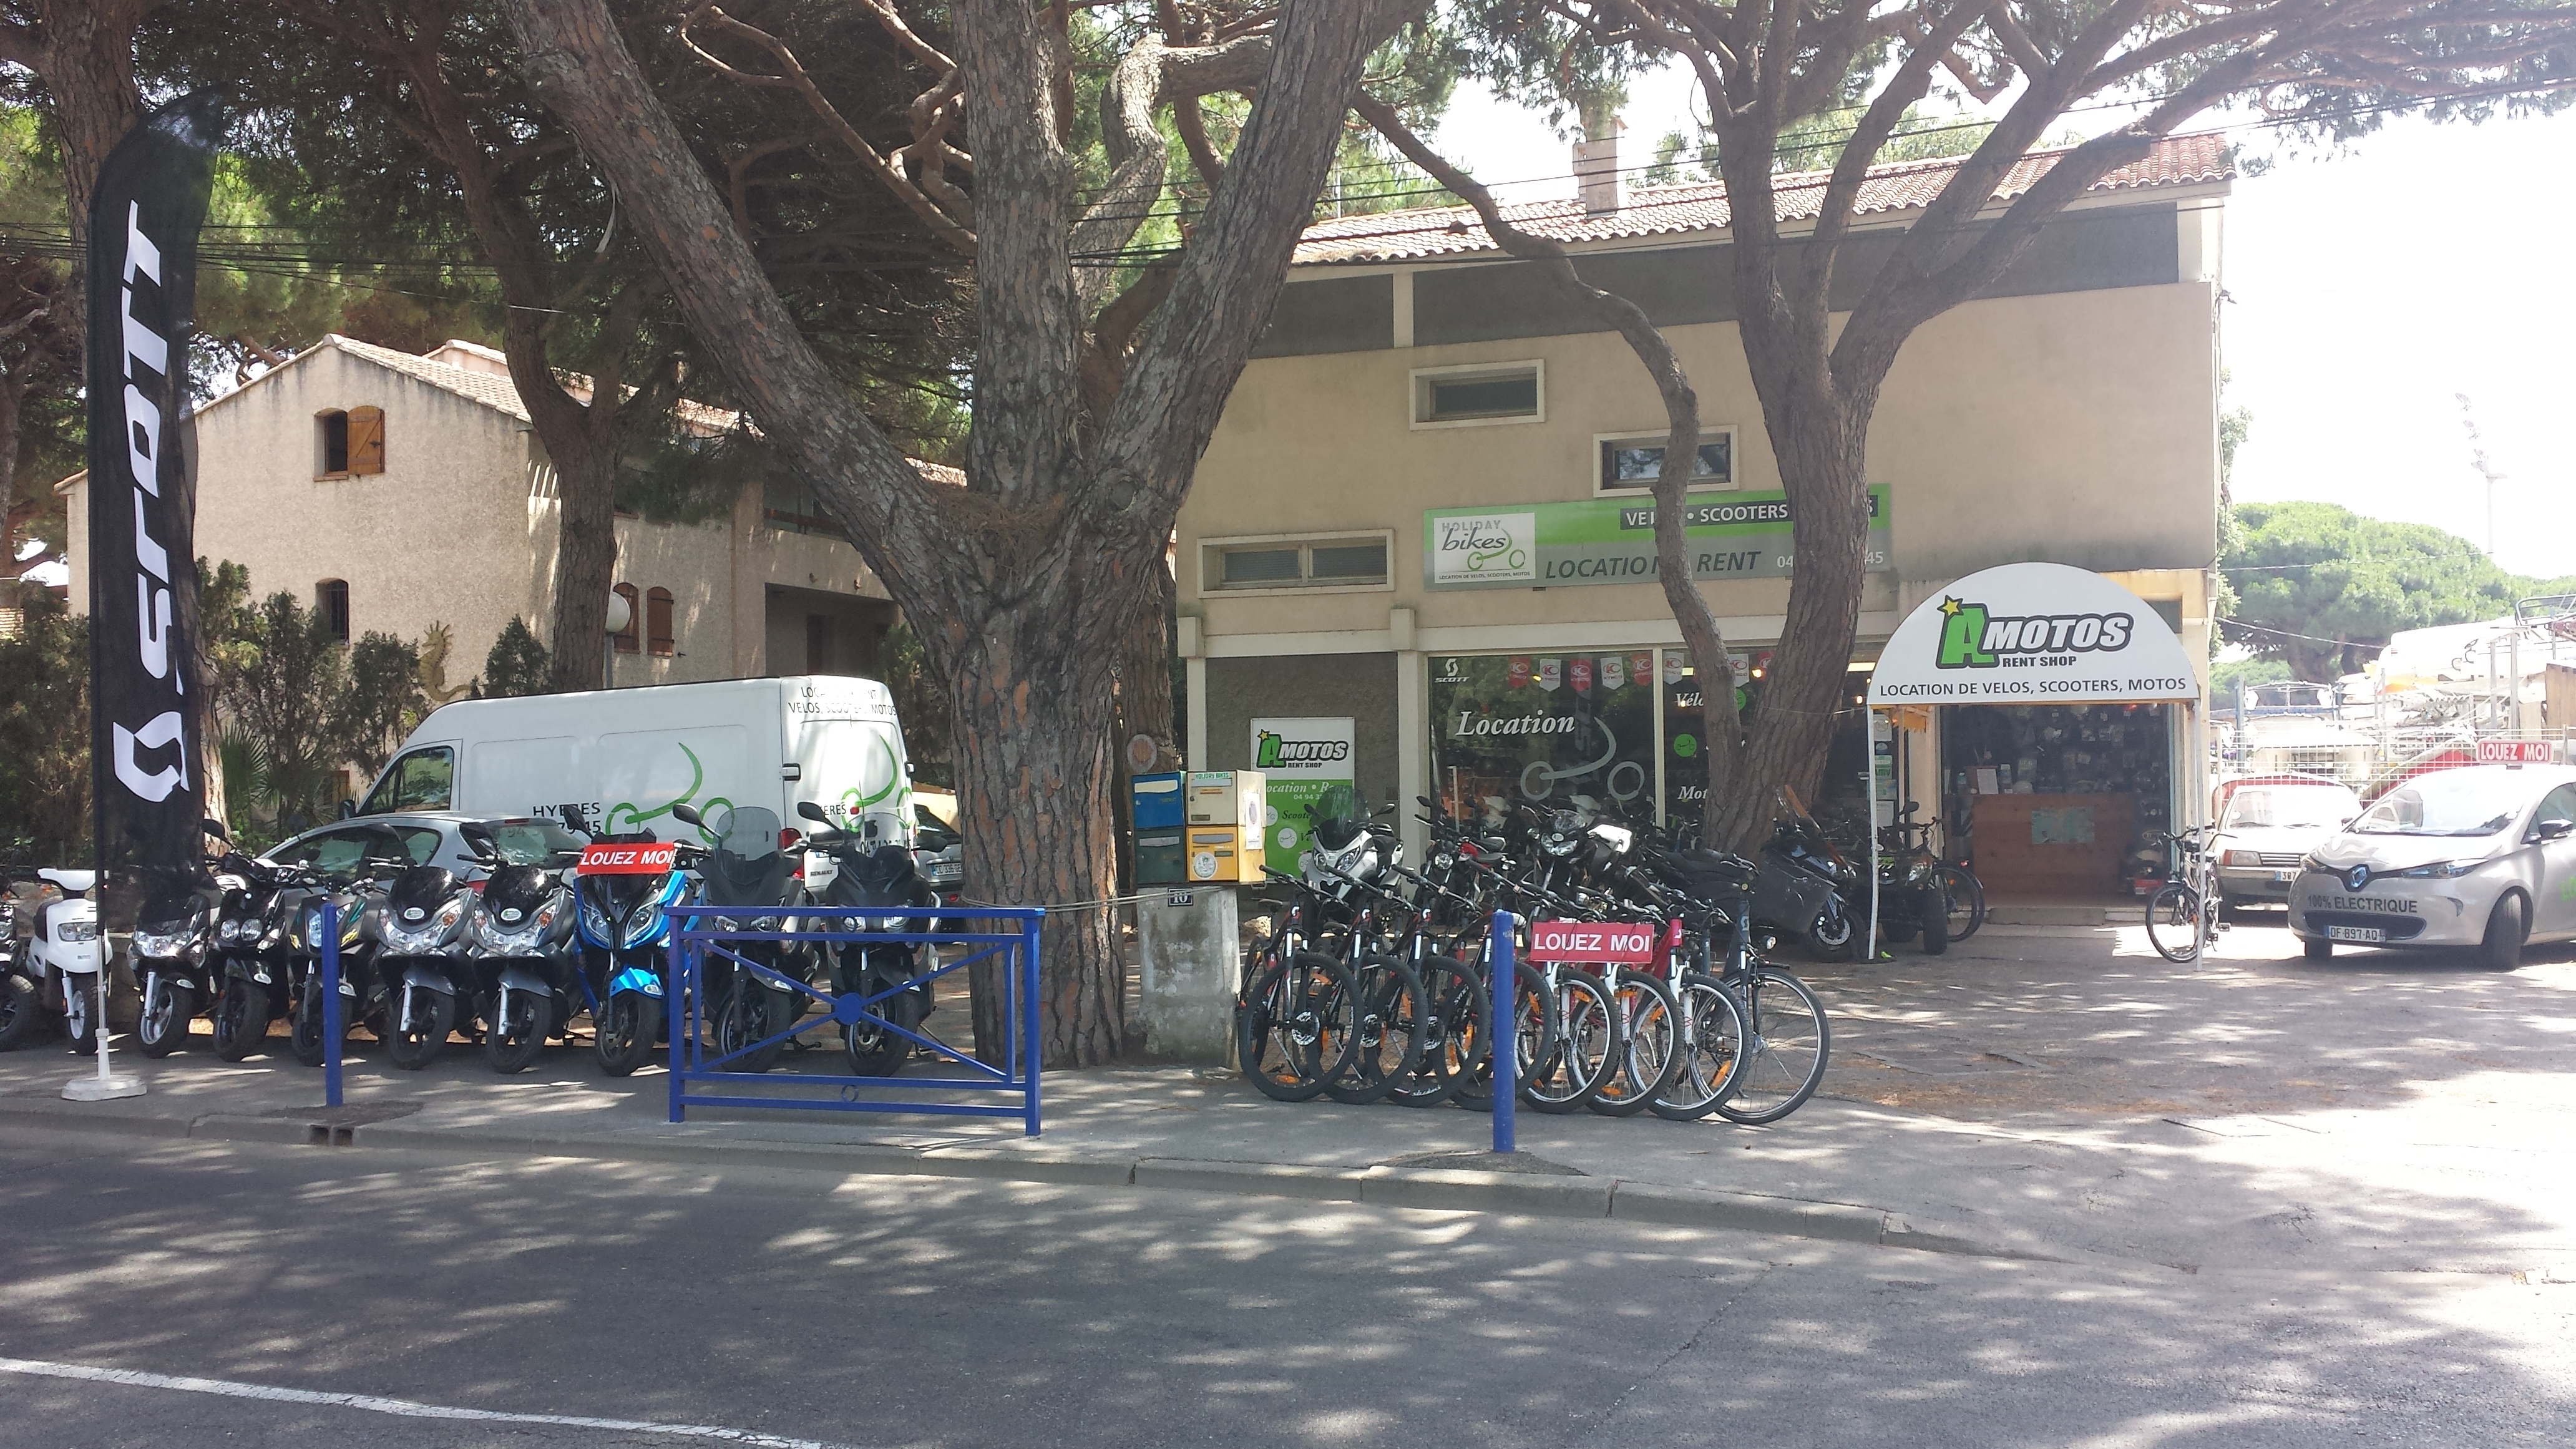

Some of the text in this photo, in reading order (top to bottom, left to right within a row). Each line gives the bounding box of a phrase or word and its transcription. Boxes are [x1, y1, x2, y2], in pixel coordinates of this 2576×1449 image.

[1700, 504, 1788, 523] SCOOTERS
[1442, 520, 1501, 532] HOLIDAY
[1442, 527, 1506, 551] bikes
[1697, 551, 1762, 572] RENT
[1777, 555, 1793, 568] 04
[1865, 551, 1884, 564] 45
[2003, 655, 2077, 668] RENT SHOP
[1880, 678, 2186, 696] LOCATION DE VELOS, SCOOTERS, MOTOS
[1455, 709, 1575, 736] Location
[2481, 743, 2549, 761] LOUEZ MOI
[1267, 782, 1307, 793] ocation
[1282, 810, 1311, 819] Scoote
[580, 851, 637, 866] LOUEZ
[641, 849, 674, 864] MOI
[2308, 895, 2418, 913] 100% ELECTRIQUE
[1534, 933, 1650, 952] LOUEZ MOI
